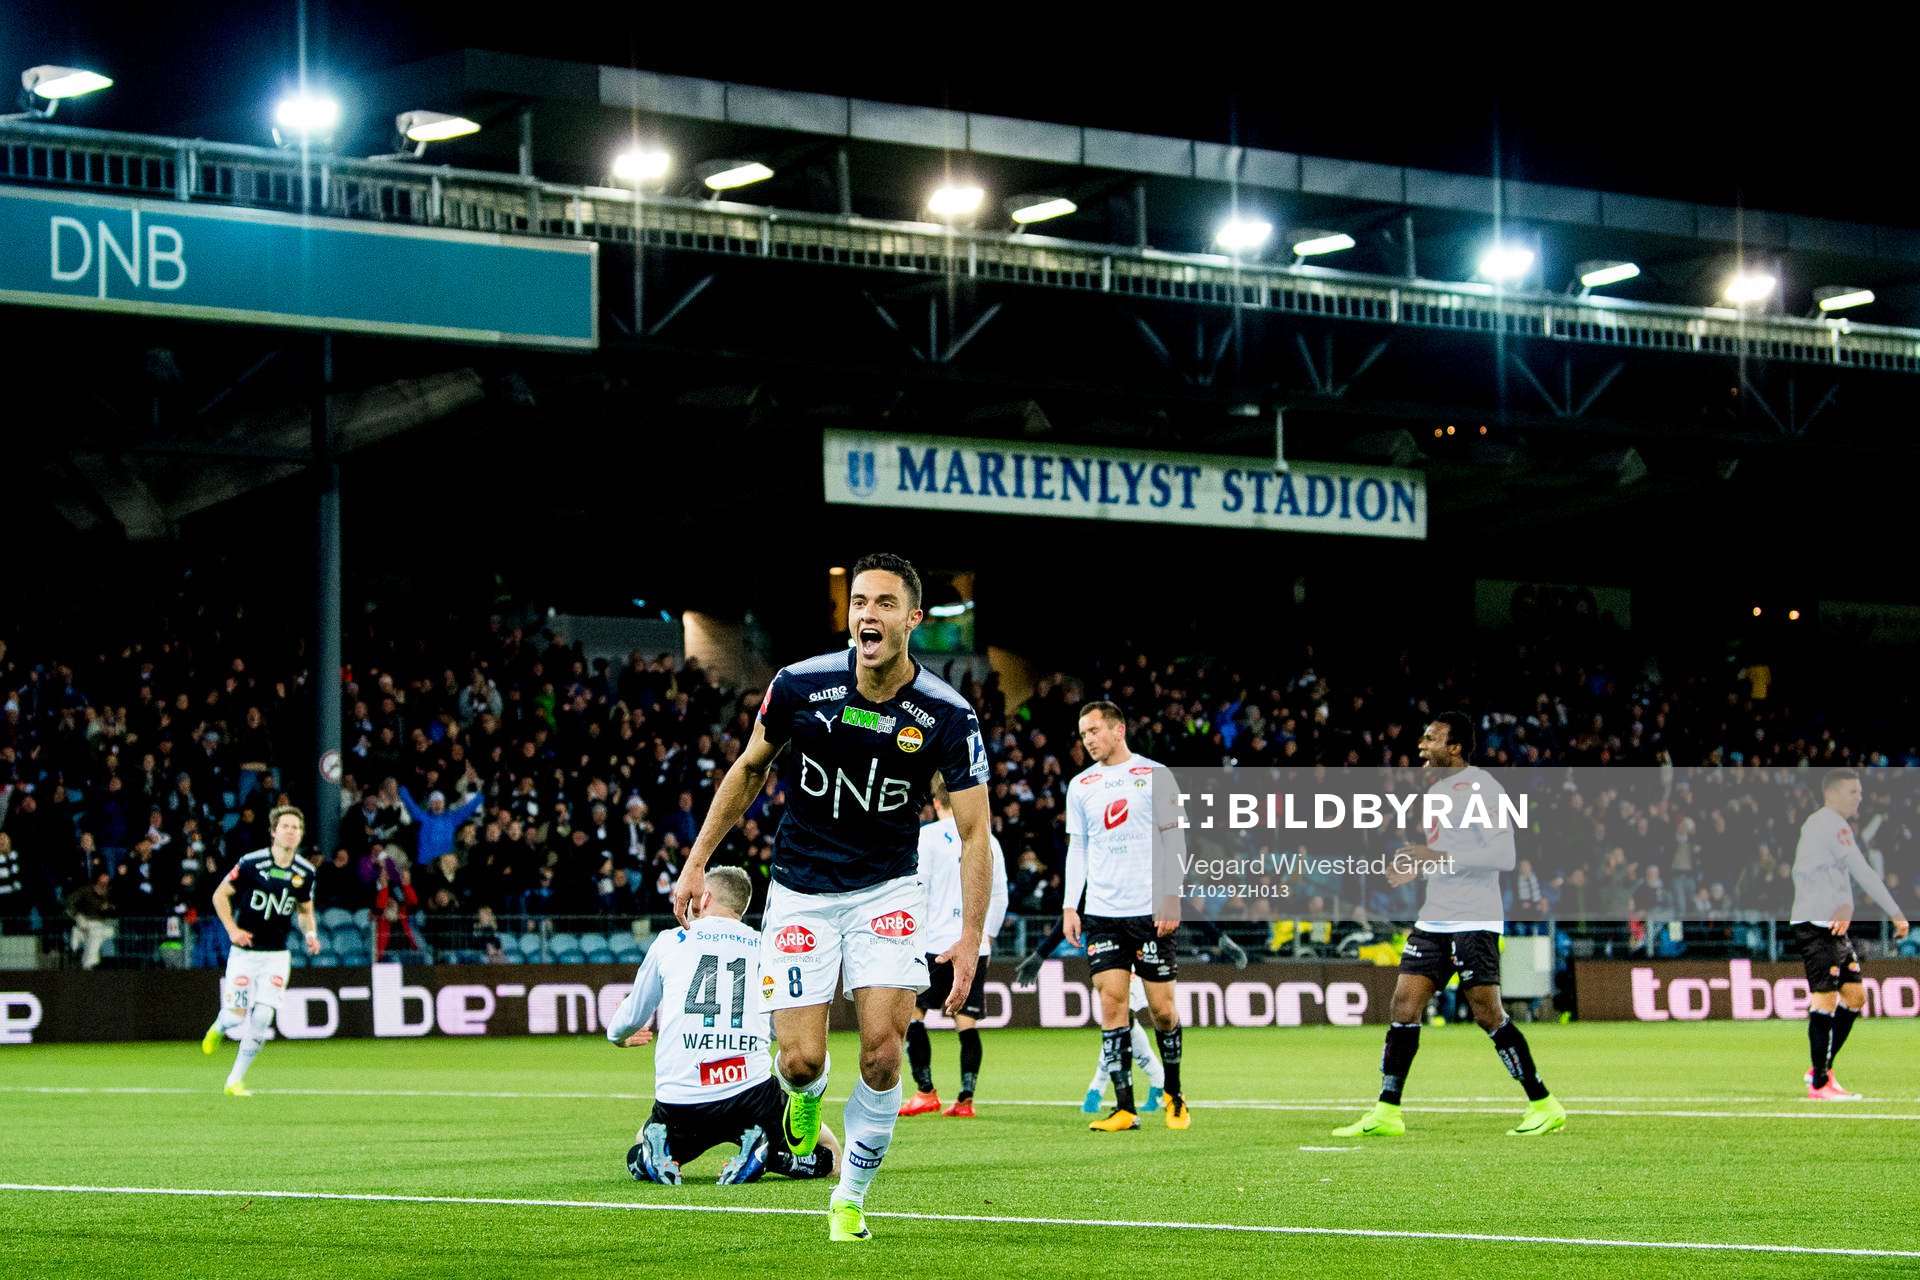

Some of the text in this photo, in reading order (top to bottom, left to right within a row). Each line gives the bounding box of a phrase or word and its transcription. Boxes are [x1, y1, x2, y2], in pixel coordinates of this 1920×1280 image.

[51, 208, 187, 299] DNB
[896, 445, 1417, 523] MARIENLYST STADION
[842, 705, 880, 730] KIWI
[879, 715, 897, 726] mini
[877, 723, 893, 733] pris
[800, 752, 911, 820] DNB
[250, 887, 297, 920] DNB
[873, 916, 916, 932] ARBO
[775, 933, 817, 948] ARBO
[1142, 940, 1158, 954] 40
[684, 954, 746, 1028] 41
[787, 966, 803, 998] 8
[234, 989, 249, 1008] 26
[682, 1033, 758, 1051] WÆHLER
[850, 1154, 880, 1167] ENTER
